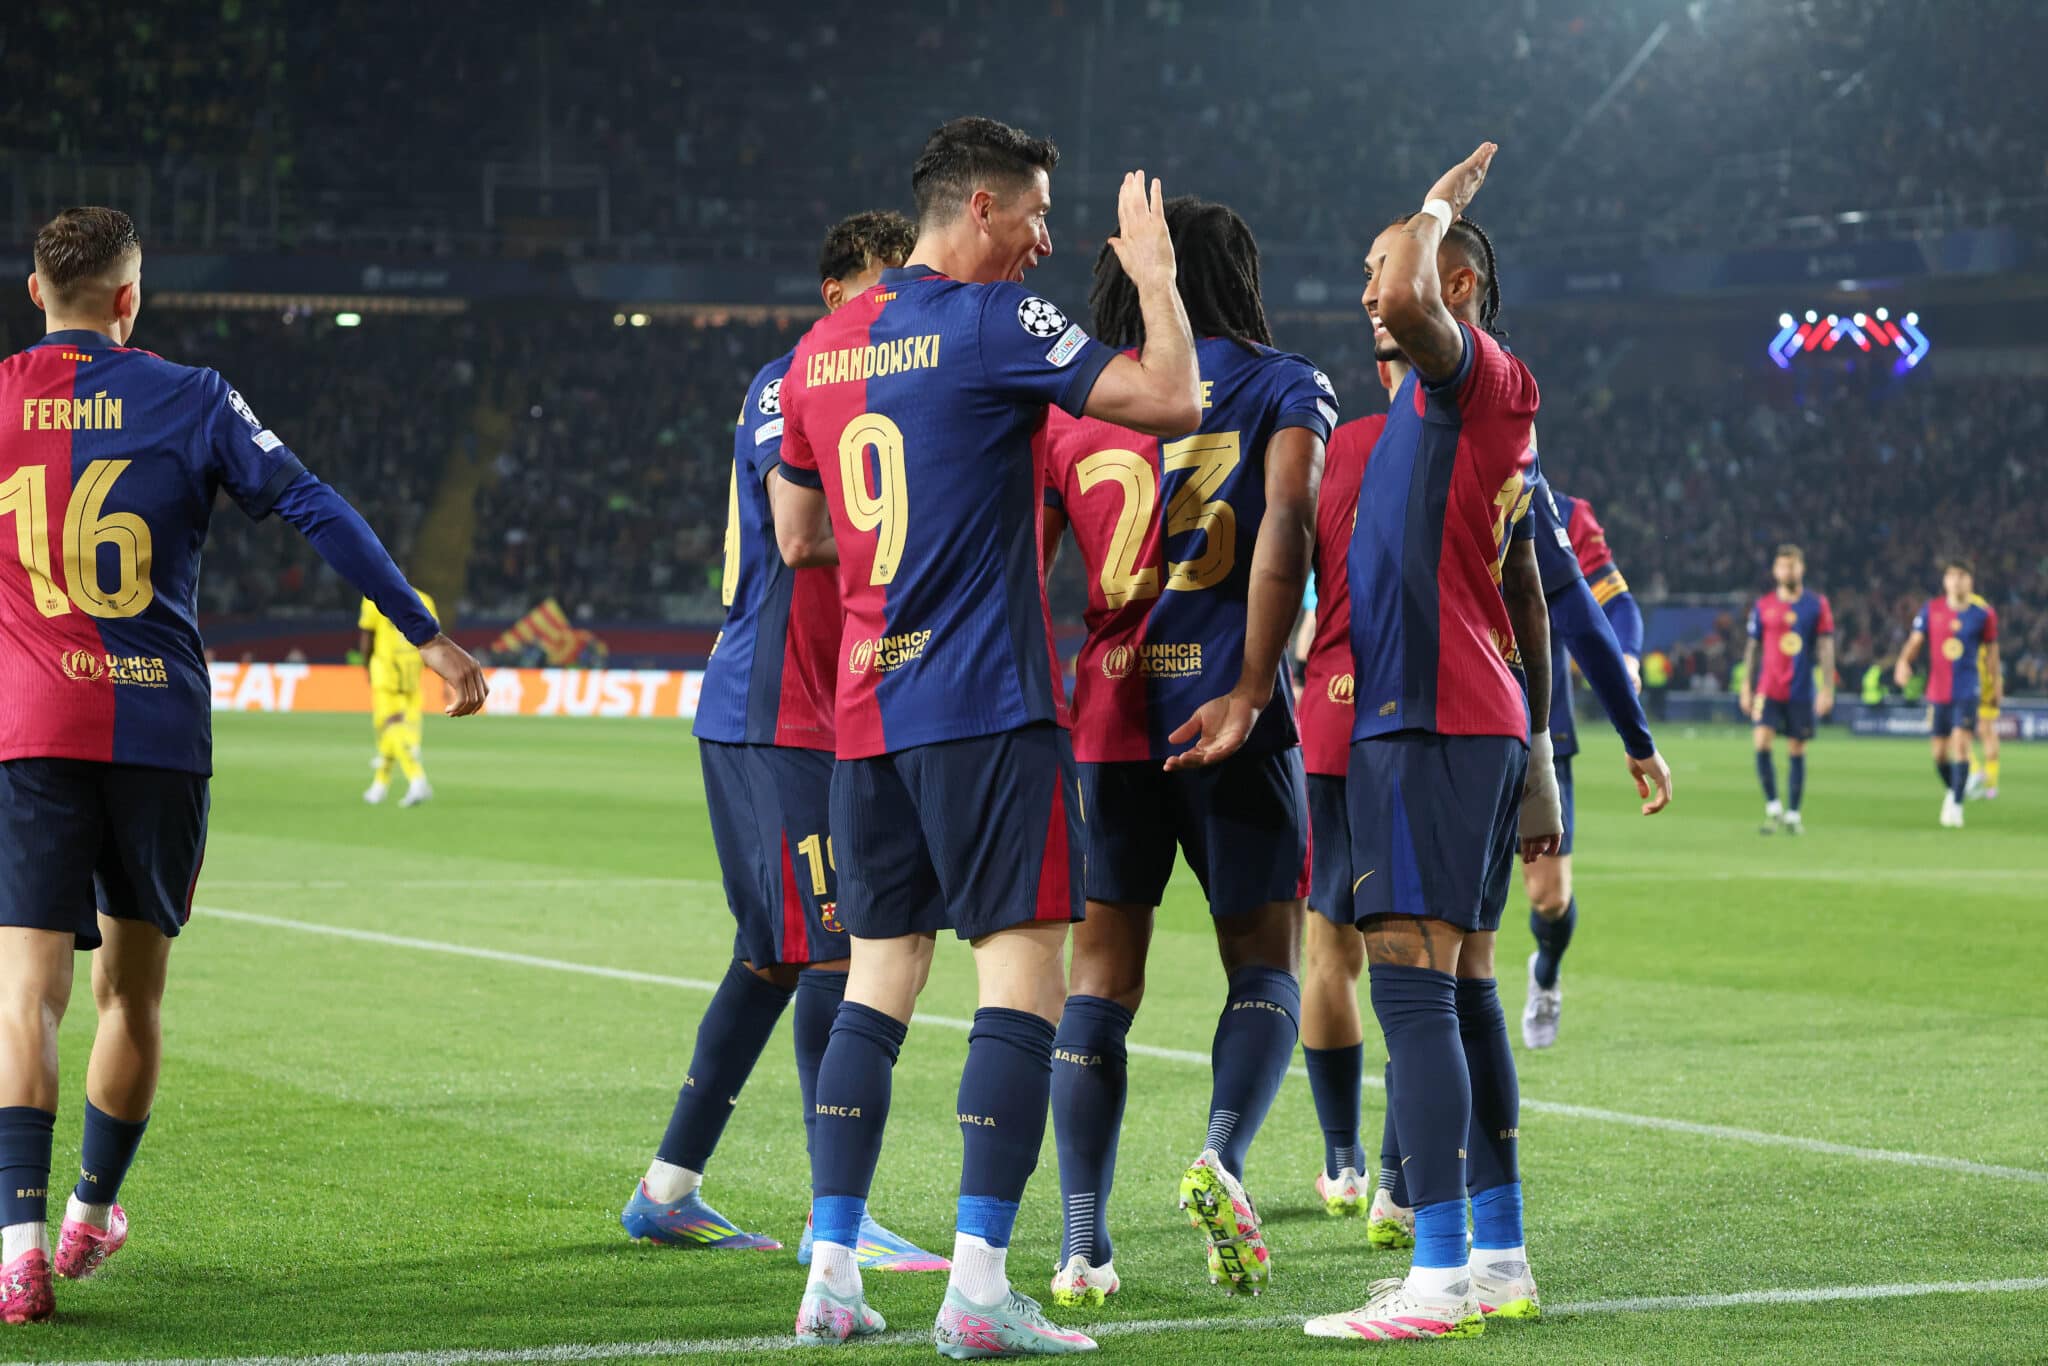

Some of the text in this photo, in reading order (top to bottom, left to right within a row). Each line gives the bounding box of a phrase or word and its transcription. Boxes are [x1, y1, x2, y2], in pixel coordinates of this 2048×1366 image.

[806, 334, 941, 389] LEWANDOWSKI
[23, 390, 122, 431] FERMÍN
[838, 412, 909, 586] 9
[1075, 431, 1241, 610] 23
[0, 459, 154, 619] 16
[874, 629, 932, 652] UNHCR
[1139, 643, 1202, 657] UNHCR
[1139, 657, 1202, 672] ACNUR
[107, 667, 168, 682] ACNUR
[209, 662, 310, 712] EAT
[535, 668, 672, 717] JUST
[797, 833, 837, 896] 1
